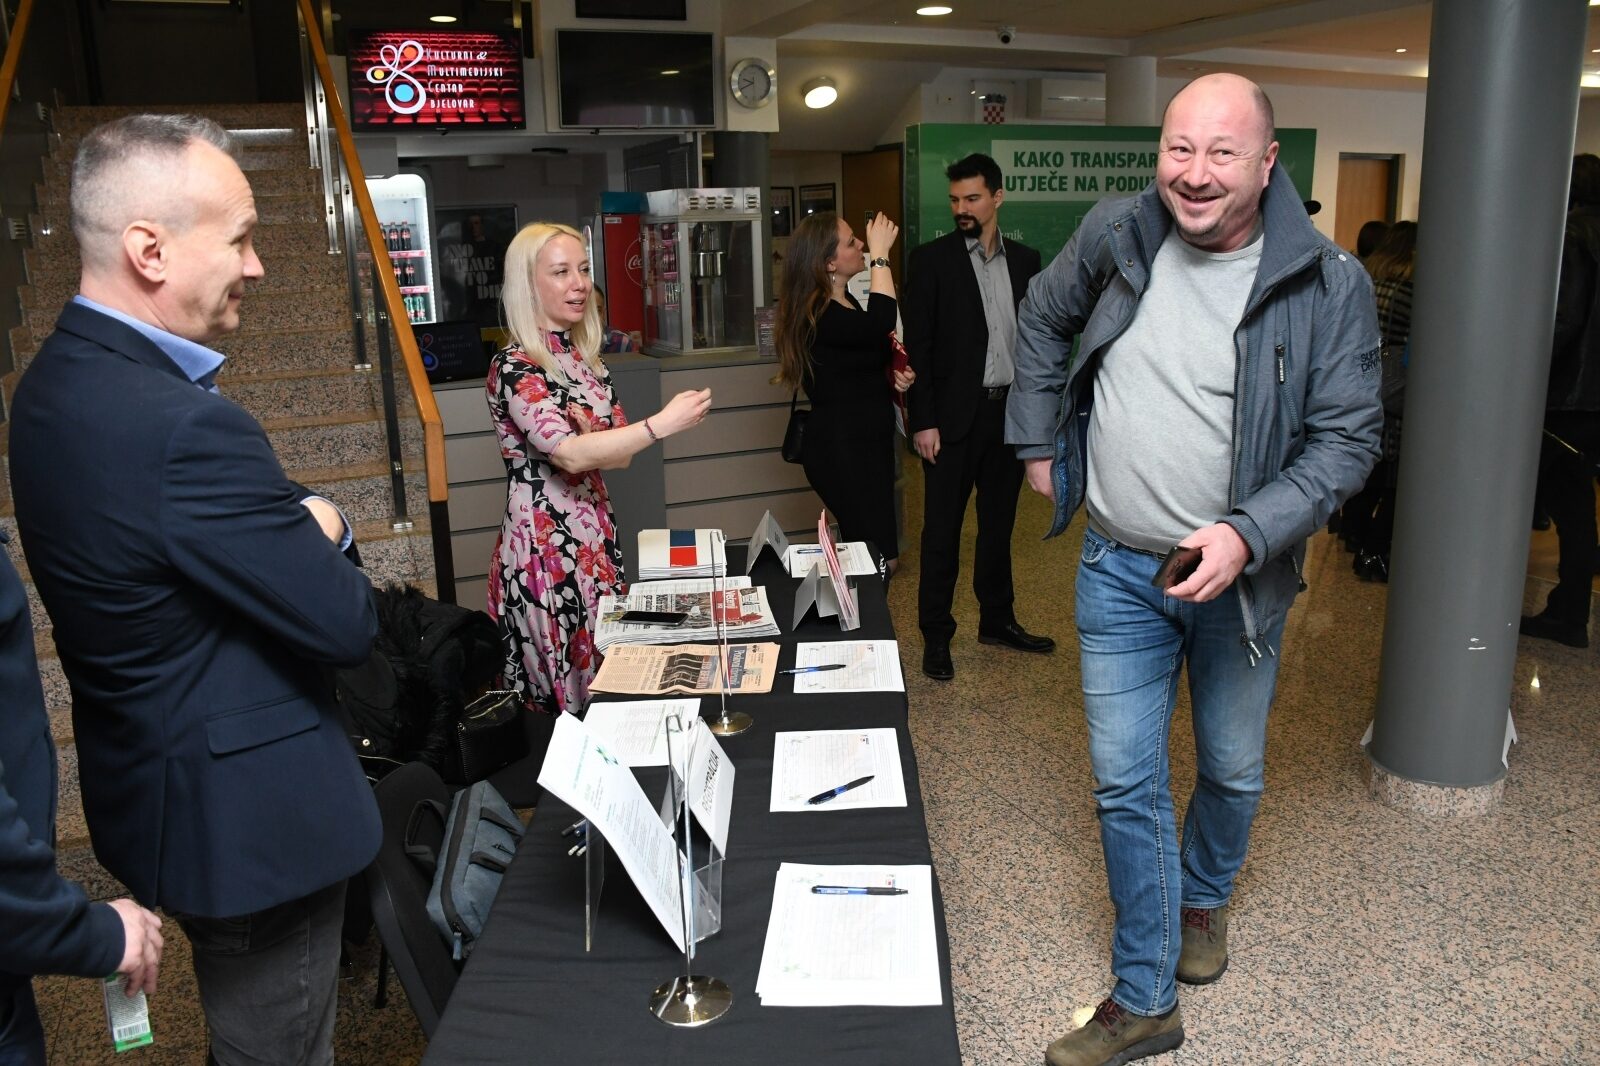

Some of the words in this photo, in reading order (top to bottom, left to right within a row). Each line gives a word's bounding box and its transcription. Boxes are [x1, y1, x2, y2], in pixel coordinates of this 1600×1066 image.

[426, 48, 473, 60] KULTURNI
[427, 64, 503, 76] MULTIMEDIJSKI
[428, 80, 464, 92] CENTAR
[430, 99, 474, 108] BJELOVAR
[1014, 152, 1064, 168] KAKO
[1006, 171, 1068, 192] UTJEČE
[1074, 176, 1098, 192] NA
[1105, 176, 1156, 192] PODU
[446, 244, 474, 258] NO
[450, 256, 494, 272] TIME
[464, 271, 488, 286] TO
